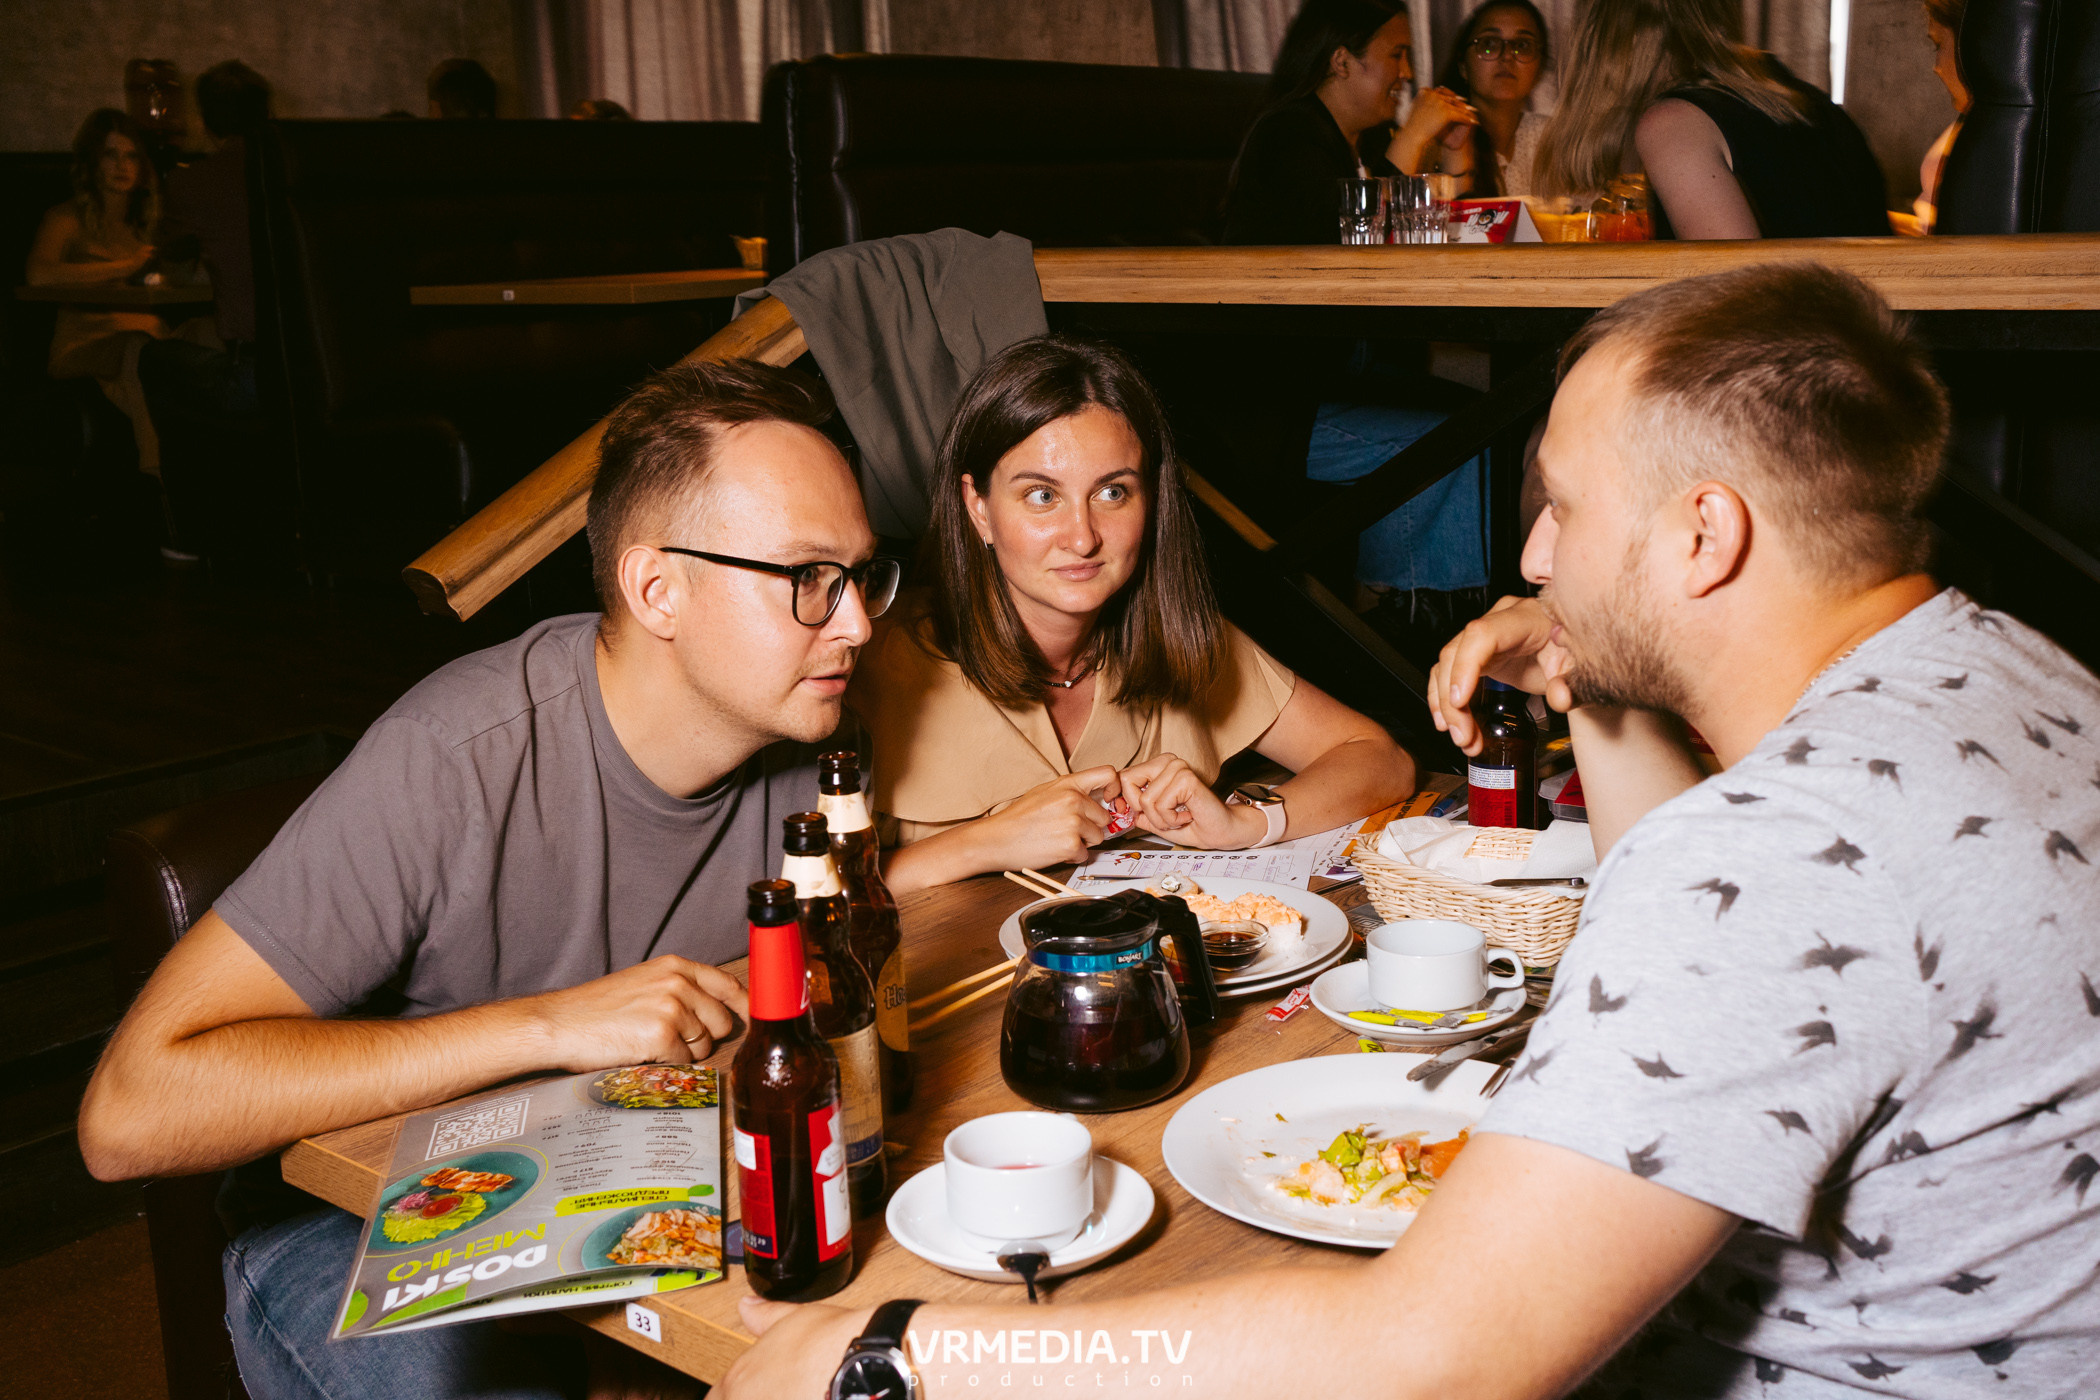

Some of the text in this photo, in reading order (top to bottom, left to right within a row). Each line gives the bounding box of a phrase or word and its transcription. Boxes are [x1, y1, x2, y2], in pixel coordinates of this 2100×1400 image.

[575, 1196, 669, 1210] СПЕЦИАЛЬНЫЕ
[387, 1223, 546, 1282] МЕНЮ
[382, 1244, 548, 1312] DOSKI
[634, 1311, 652, 1332] 33
